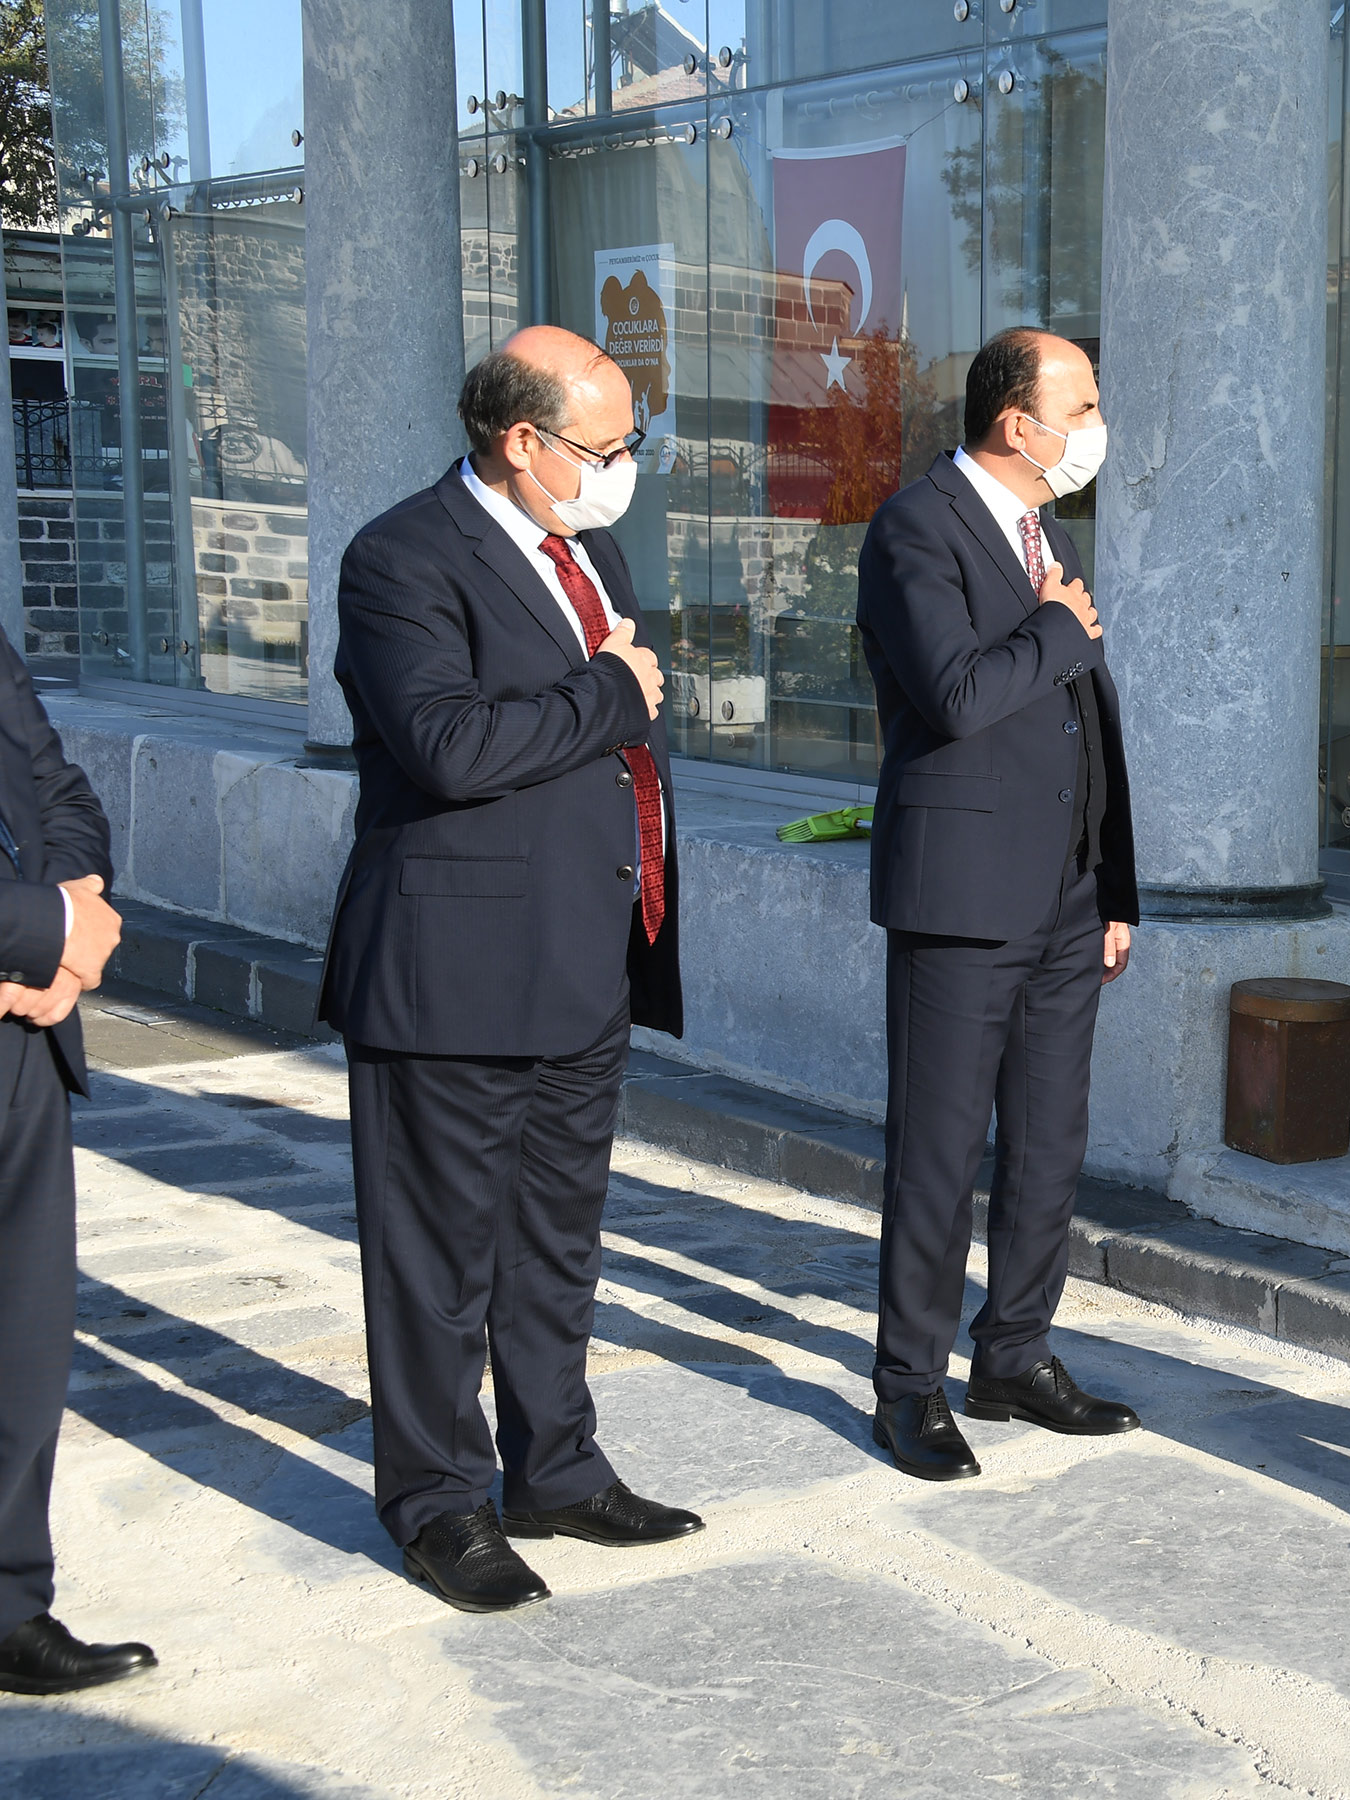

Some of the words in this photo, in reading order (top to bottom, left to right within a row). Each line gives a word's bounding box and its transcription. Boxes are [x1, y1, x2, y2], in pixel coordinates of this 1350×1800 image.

[612, 319, 659, 338] ÇOCUKLARA
[609, 337, 633, 355] DEĞER
[634, 335, 664, 353] VERİRDİ
